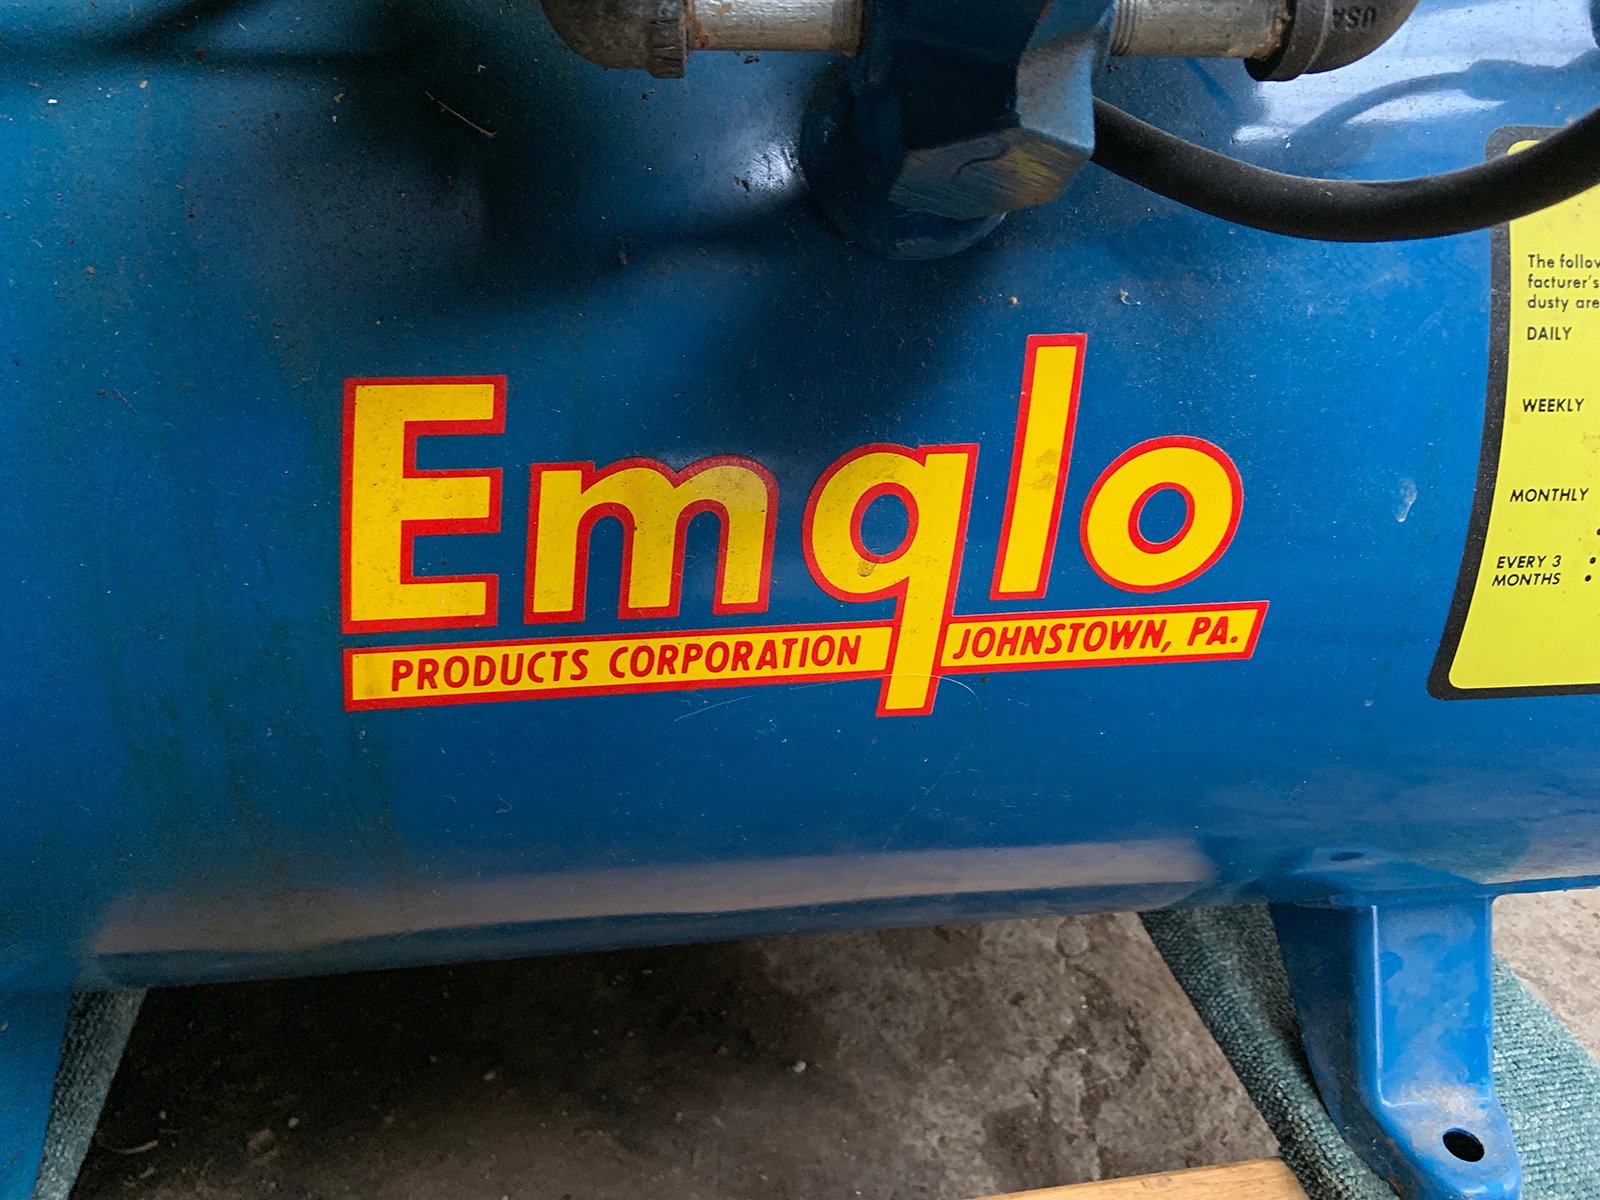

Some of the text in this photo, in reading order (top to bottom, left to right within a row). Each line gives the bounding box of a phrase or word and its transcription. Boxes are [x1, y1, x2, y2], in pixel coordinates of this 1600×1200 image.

[1527, 253, 1555, 268] The
[1527, 273, 1600, 288] facturer's
[1527, 293, 1569, 313] dusty
[1526, 326, 1573, 341] DAILY
[1522, 398, 1585, 413] WEEKLY
[1509, 488, 1590, 502] MONTHLY
[1496, 555, 1562, 569] EVERY 3
[1491, 573, 1562, 587] MONTHS
[391, 615, 1239, 692] PRODUCTS CORPORATION JOHNSTOWN, PA.
